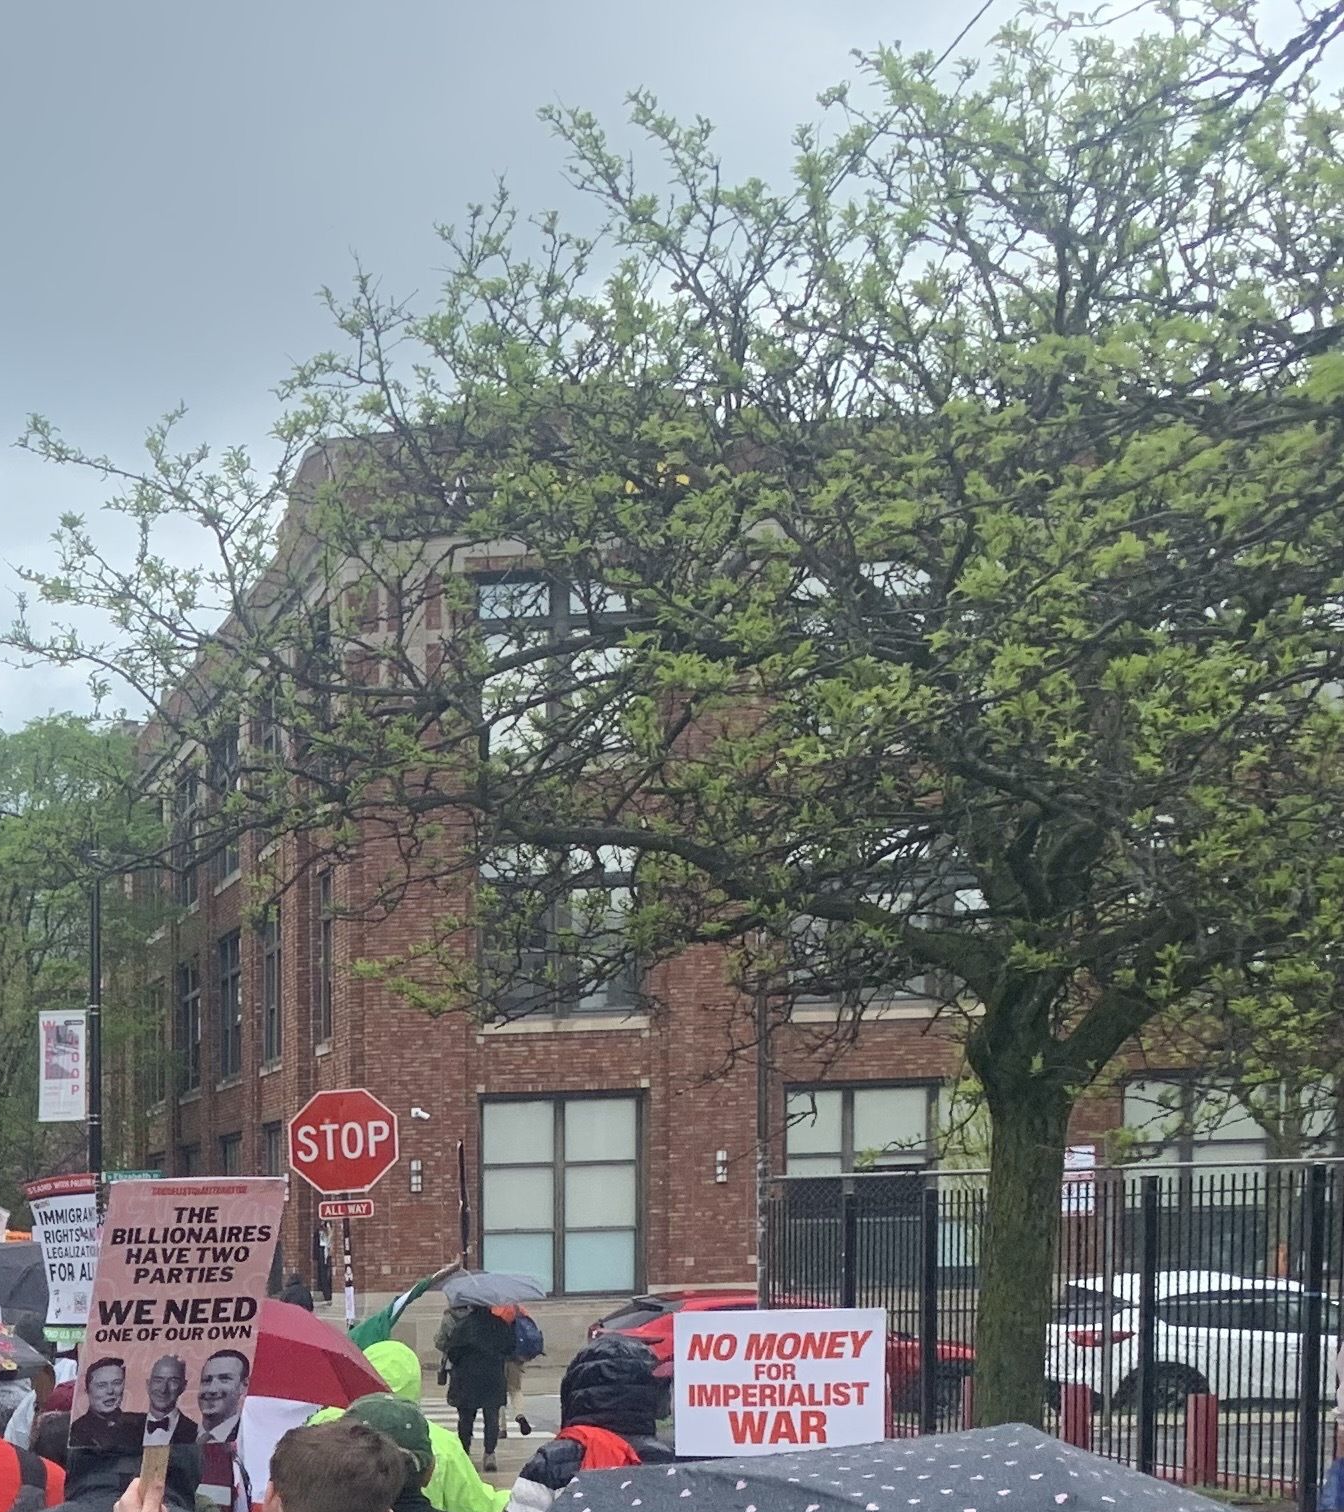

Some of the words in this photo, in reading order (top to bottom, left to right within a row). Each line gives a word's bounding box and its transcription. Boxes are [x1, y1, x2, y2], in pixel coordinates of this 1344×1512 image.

[297, 1121, 390, 1163] STOP
[174, 1207, 219, 1224] THE
[325, 1206, 344, 1216] ALL
[349, 1203, 368, 1215] WAY
[44, 1229, 80, 1244] RIGHTS
[111, 1225, 272, 1246] BILLIONAIRES
[125, 1248, 190, 1265] HAVE
[197, 1246, 250, 1263] TWO
[49, 1264, 75, 1282] FOR
[133, 1267, 234, 1284] PARTIES
[98, 1300, 158, 1325] WE
[163, 1297, 258, 1323] NEED
[95, 1329, 133, 1343] ONE
[137, 1328, 162, 1341] OF
[165, 1327, 204, 1341] OUR
[208, 1326, 252, 1340] OWN
[687, 1333, 737, 1361] NO
[744, 1330, 873, 1361] MONEY
[754, 1363, 796, 1381] FOR
[688, 1382, 870, 1407] IMPERIALIST
[728, 1411, 828, 1444] WAR
